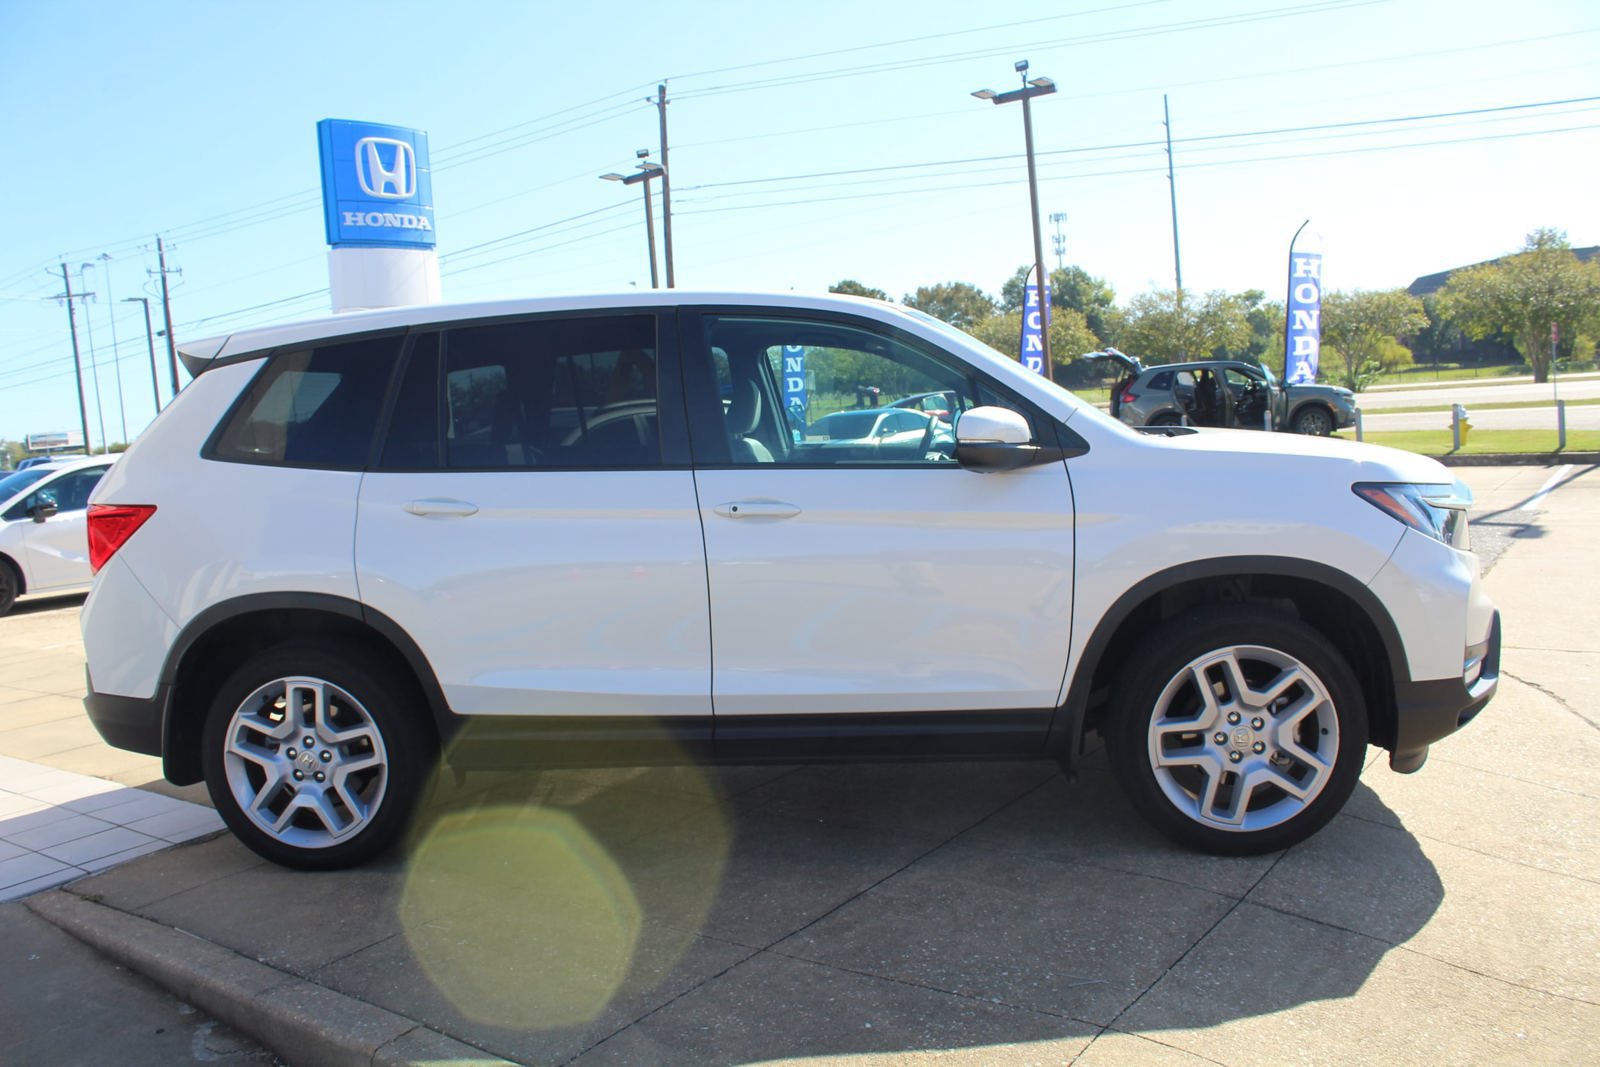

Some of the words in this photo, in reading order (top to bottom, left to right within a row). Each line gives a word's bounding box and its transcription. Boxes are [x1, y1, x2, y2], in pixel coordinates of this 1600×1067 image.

[343, 211, 432, 231] HONDA
[1026, 290, 1048, 373] HOND
[1290, 258, 1320, 383] HONDA
